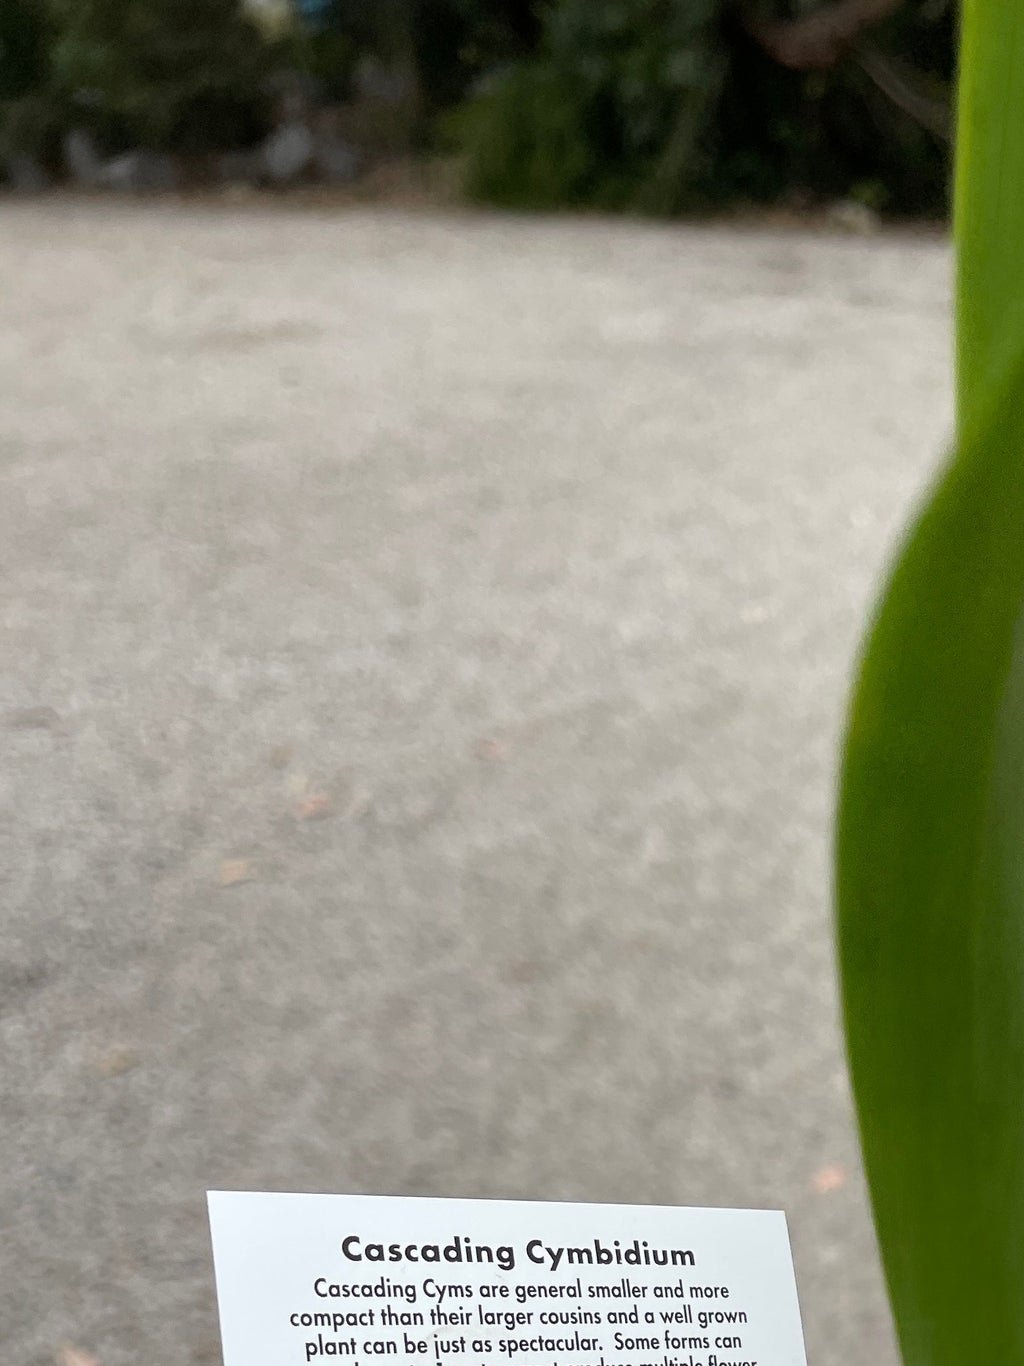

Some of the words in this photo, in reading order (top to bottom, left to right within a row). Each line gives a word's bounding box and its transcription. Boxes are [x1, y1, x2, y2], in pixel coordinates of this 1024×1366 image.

[341, 1235, 515, 1271] Cascading
[526, 1239, 695, 1271] Cymbidium
[314, 1276, 417, 1304] Cascading
[423, 1278, 473, 1304] Cyms
[479, 1285, 510, 1298] are
[515, 1278, 582, 1304] general
[588, 1278, 648, 1298] smaller
[653, 1279, 684, 1298] and
[689, 1286, 729, 1298] more
[290, 1309, 375, 1333] compact
[380, 1304, 424, 1326] than
[430, 1304, 473, 1325] their
[478, 1304, 534, 1331] larger
[539, 1306, 602, 1325] cousins
[607, 1304, 639, 1324] and
[644, 1312, 655, 1324] a
[659, 1304, 693, 1324] well
[698, 1312, 747, 1329] grown
[305, 1333, 357, 1362] plant
[363, 1341, 397, 1355] can
[403, 1332, 428, 1354] be
[433, 1334, 466, 1359] just
[472, 1340, 492, 1353] as
[499, 1330, 603, 1358] spectacular.
[614, 1332, 660, 1350] Some
[664, 1330, 710, 1349] forms
[715, 1337, 742, 1349] can
